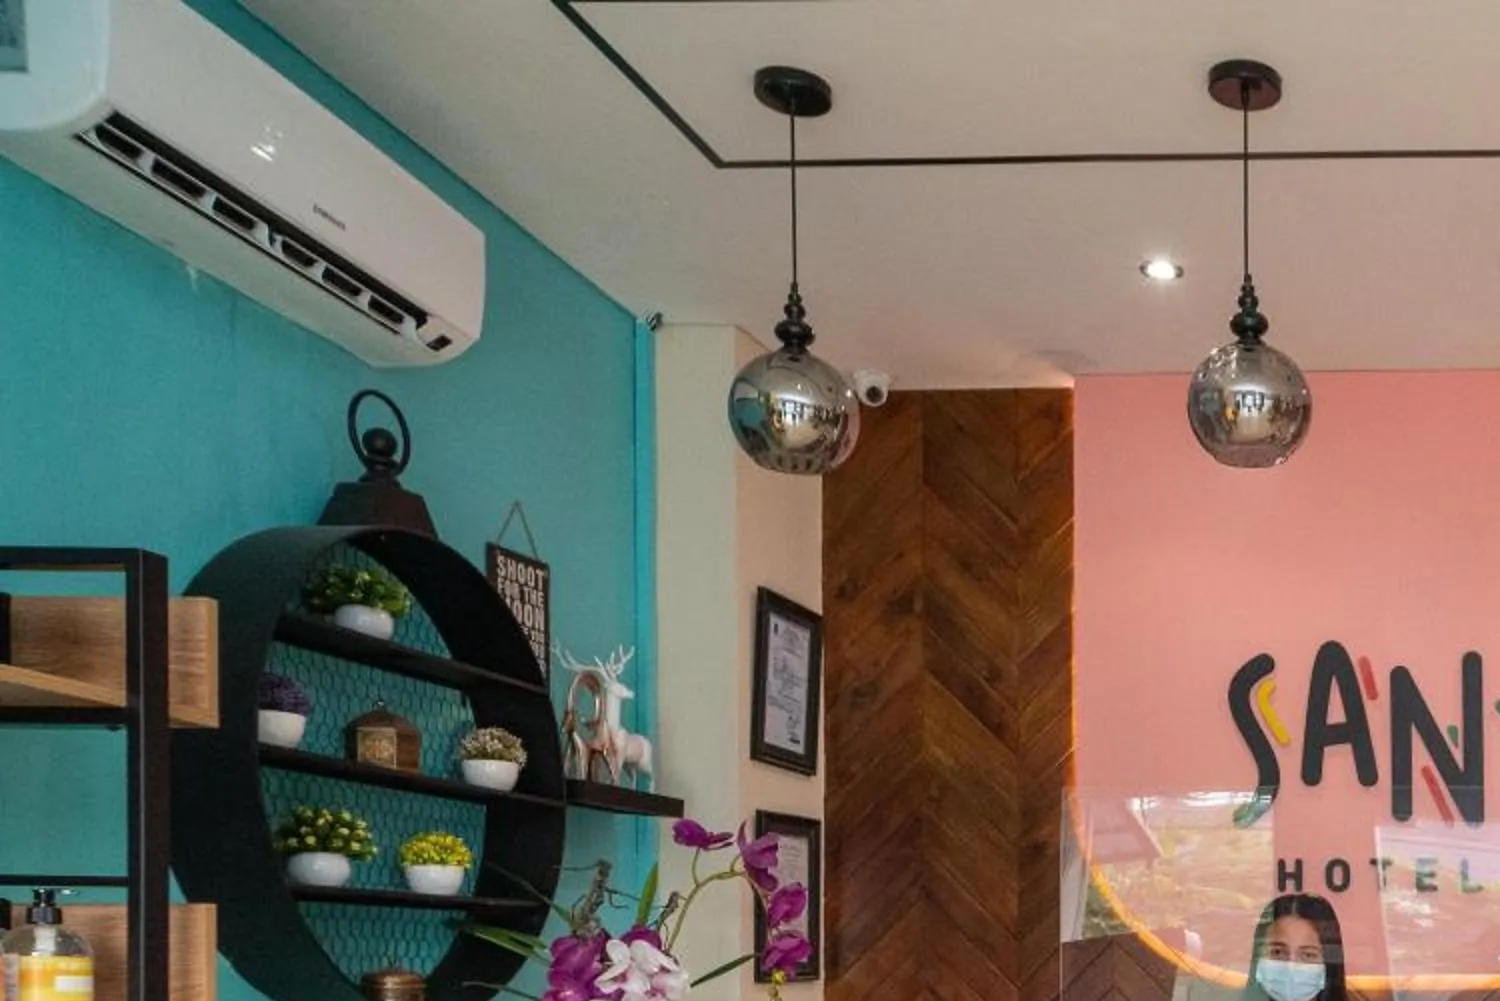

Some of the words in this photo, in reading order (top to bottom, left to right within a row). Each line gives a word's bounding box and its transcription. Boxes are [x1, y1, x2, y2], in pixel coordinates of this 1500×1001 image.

[496, 555, 545, 590] SHOOT
[523, 586, 545, 608] THE
[506, 598, 545, 631] OON
